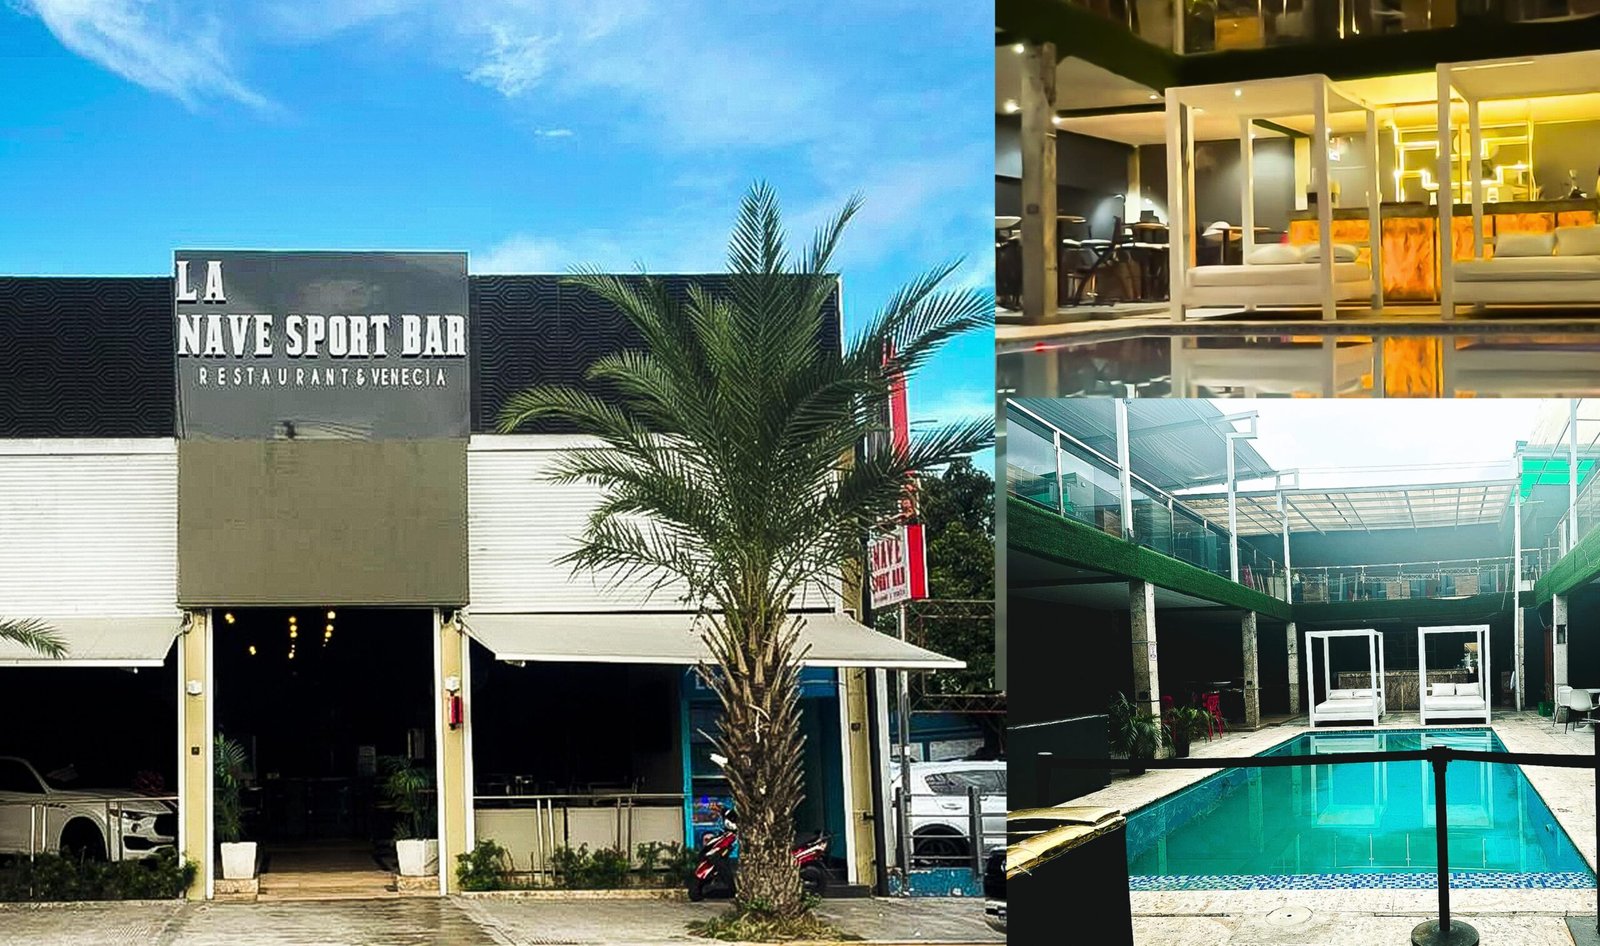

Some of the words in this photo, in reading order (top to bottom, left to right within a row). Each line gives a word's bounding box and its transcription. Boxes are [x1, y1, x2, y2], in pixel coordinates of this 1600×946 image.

[177, 261, 226, 302] LA
[177, 314, 274, 357] NAVE
[285, 314, 390, 358] SPORT
[401, 314, 467, 357] BAR
